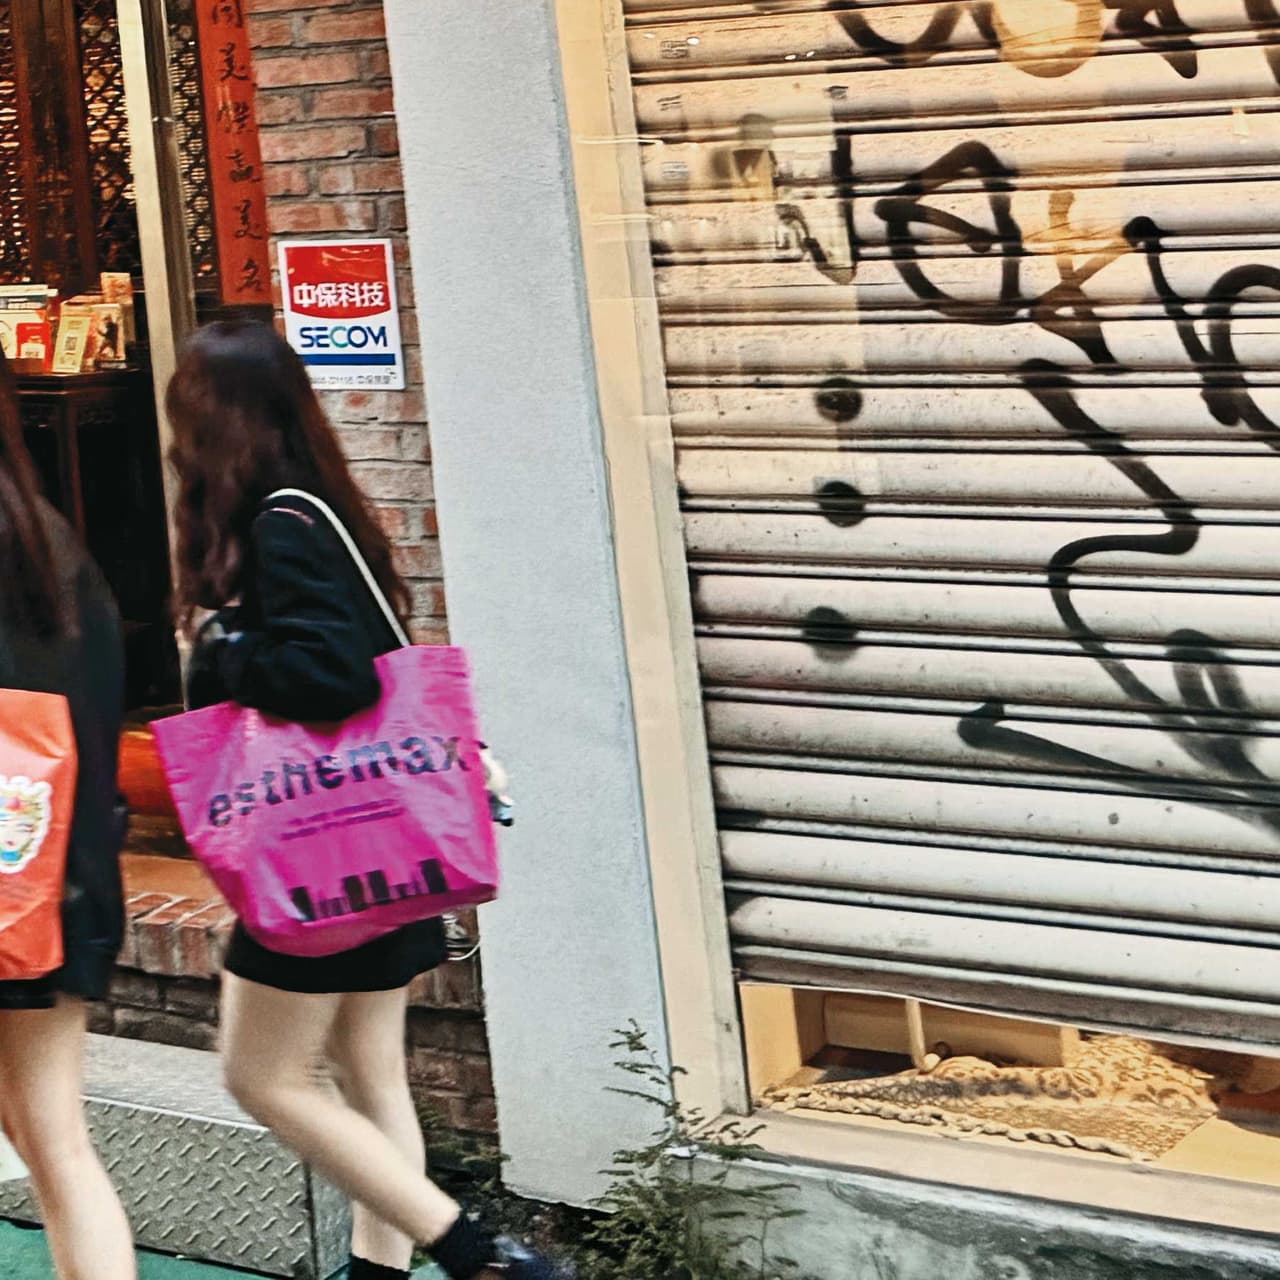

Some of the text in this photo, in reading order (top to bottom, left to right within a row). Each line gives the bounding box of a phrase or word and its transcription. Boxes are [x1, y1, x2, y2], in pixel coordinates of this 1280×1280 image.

[293, 281, 386, 309] 中保科技
[299, 325, 388, 349] SECOM
[207, 735, 472, 827] esthemax
